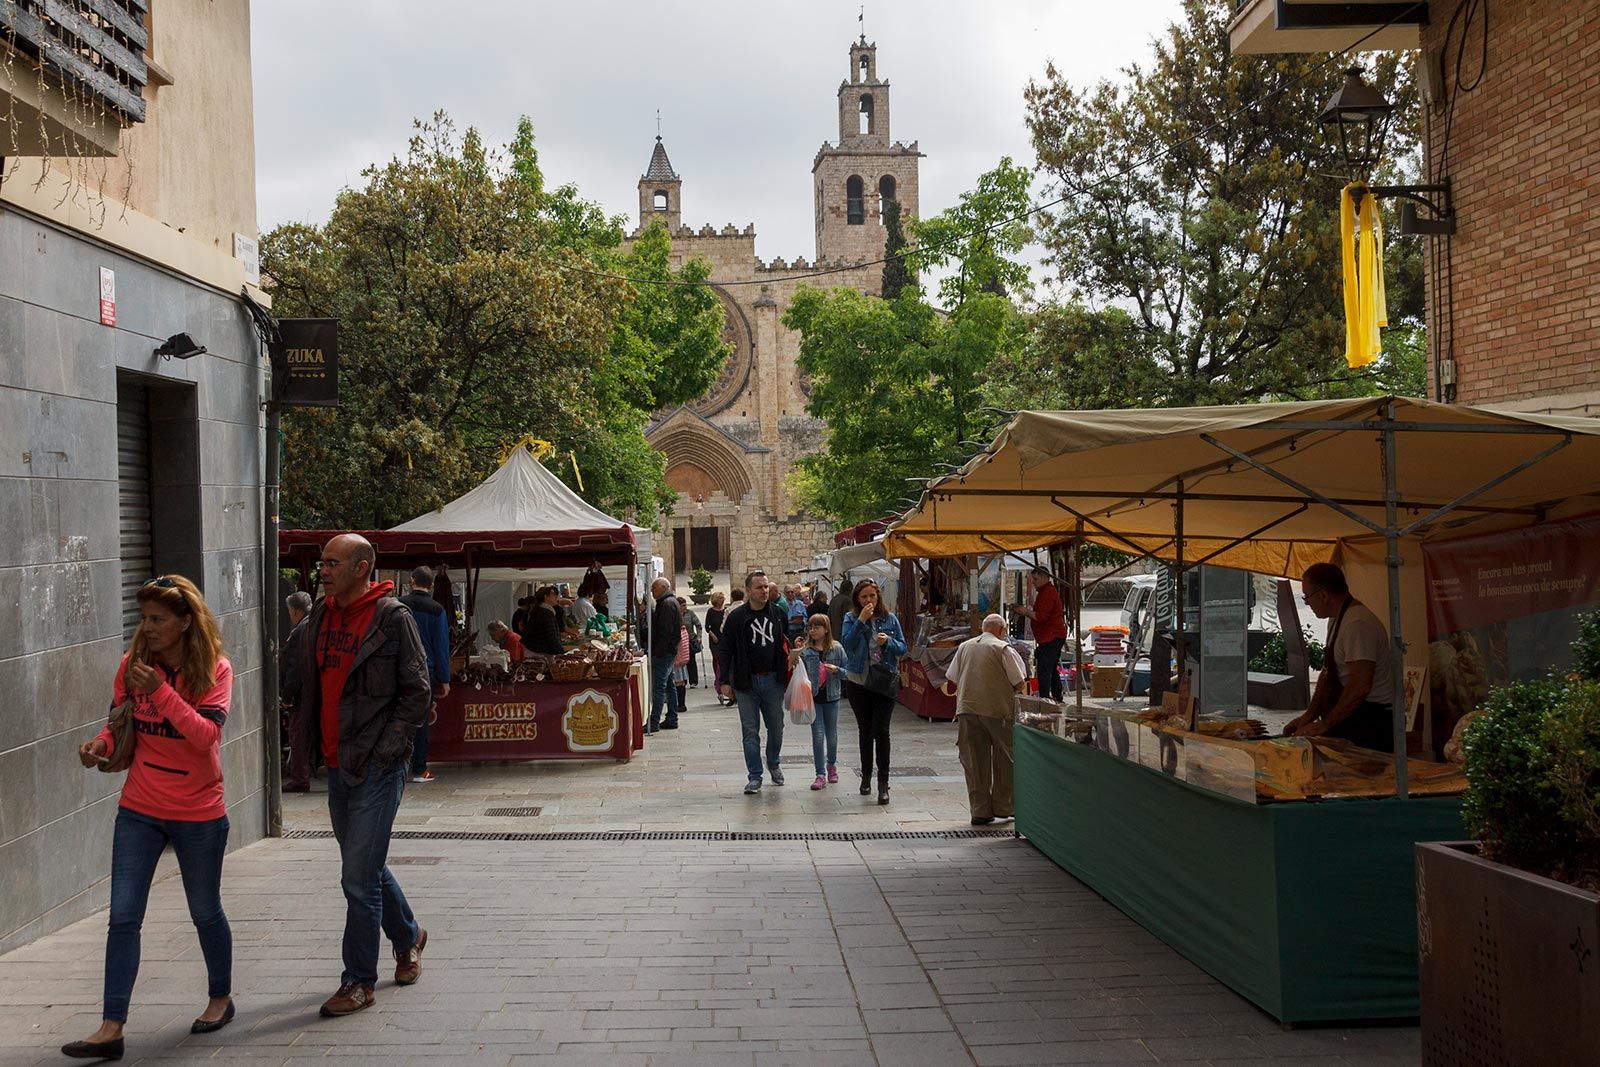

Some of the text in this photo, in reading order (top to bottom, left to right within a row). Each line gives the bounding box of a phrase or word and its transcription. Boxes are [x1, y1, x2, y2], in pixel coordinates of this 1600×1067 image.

[1512, 562, 1527, 576] has
[1522, 582, 1540, 594] coca
[1540, 577, 1551, 593] de
[1551, 575, 1587, 592] sempre?
[750, 616, 775, 647] NY
[464, 702, 536, 721] EMBOTITS
[464, 722, 537, 742] ARTESANS
